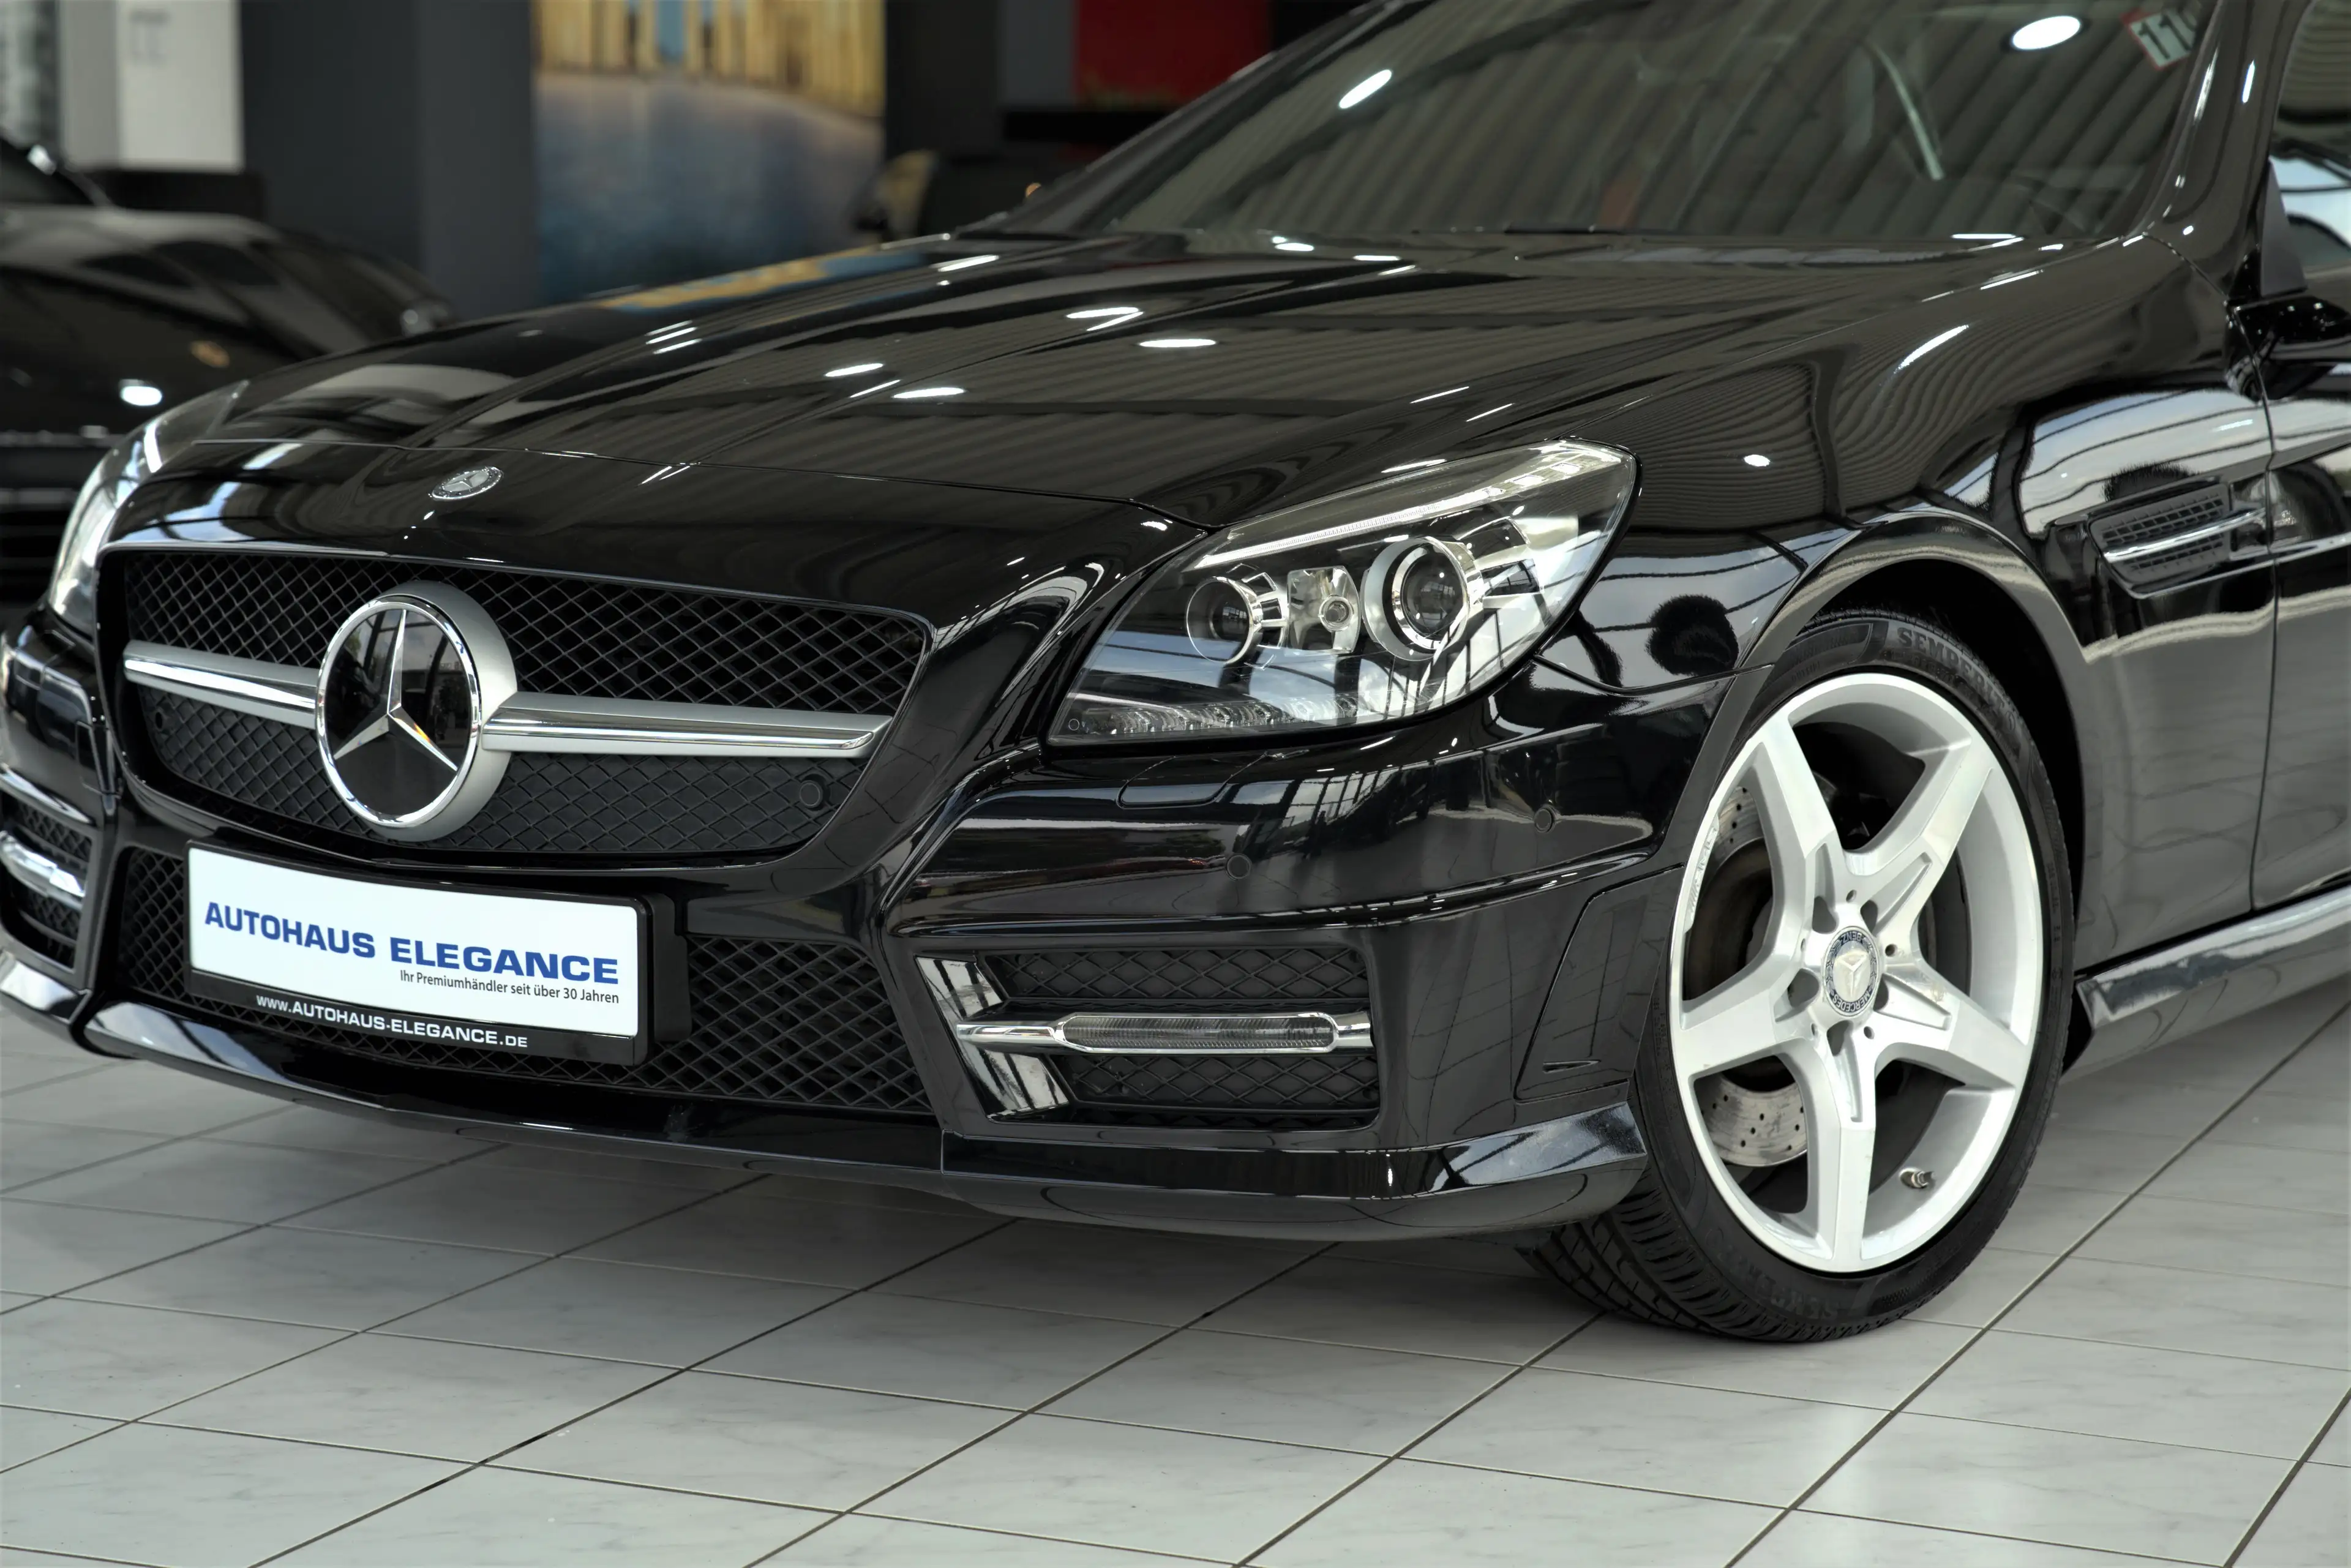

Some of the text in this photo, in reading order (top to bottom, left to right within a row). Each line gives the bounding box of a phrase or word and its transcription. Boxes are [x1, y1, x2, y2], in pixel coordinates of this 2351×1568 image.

[204, 901, 618, 985] AUTOHAUS ELEGANCE
[1841, 931, 1862, 942] BENZ
[400, 970, 619, 1003] Ihr Premiumhändler seit über 30 Jahren
[1832, 992, 1870, 1012] MERCEDES
